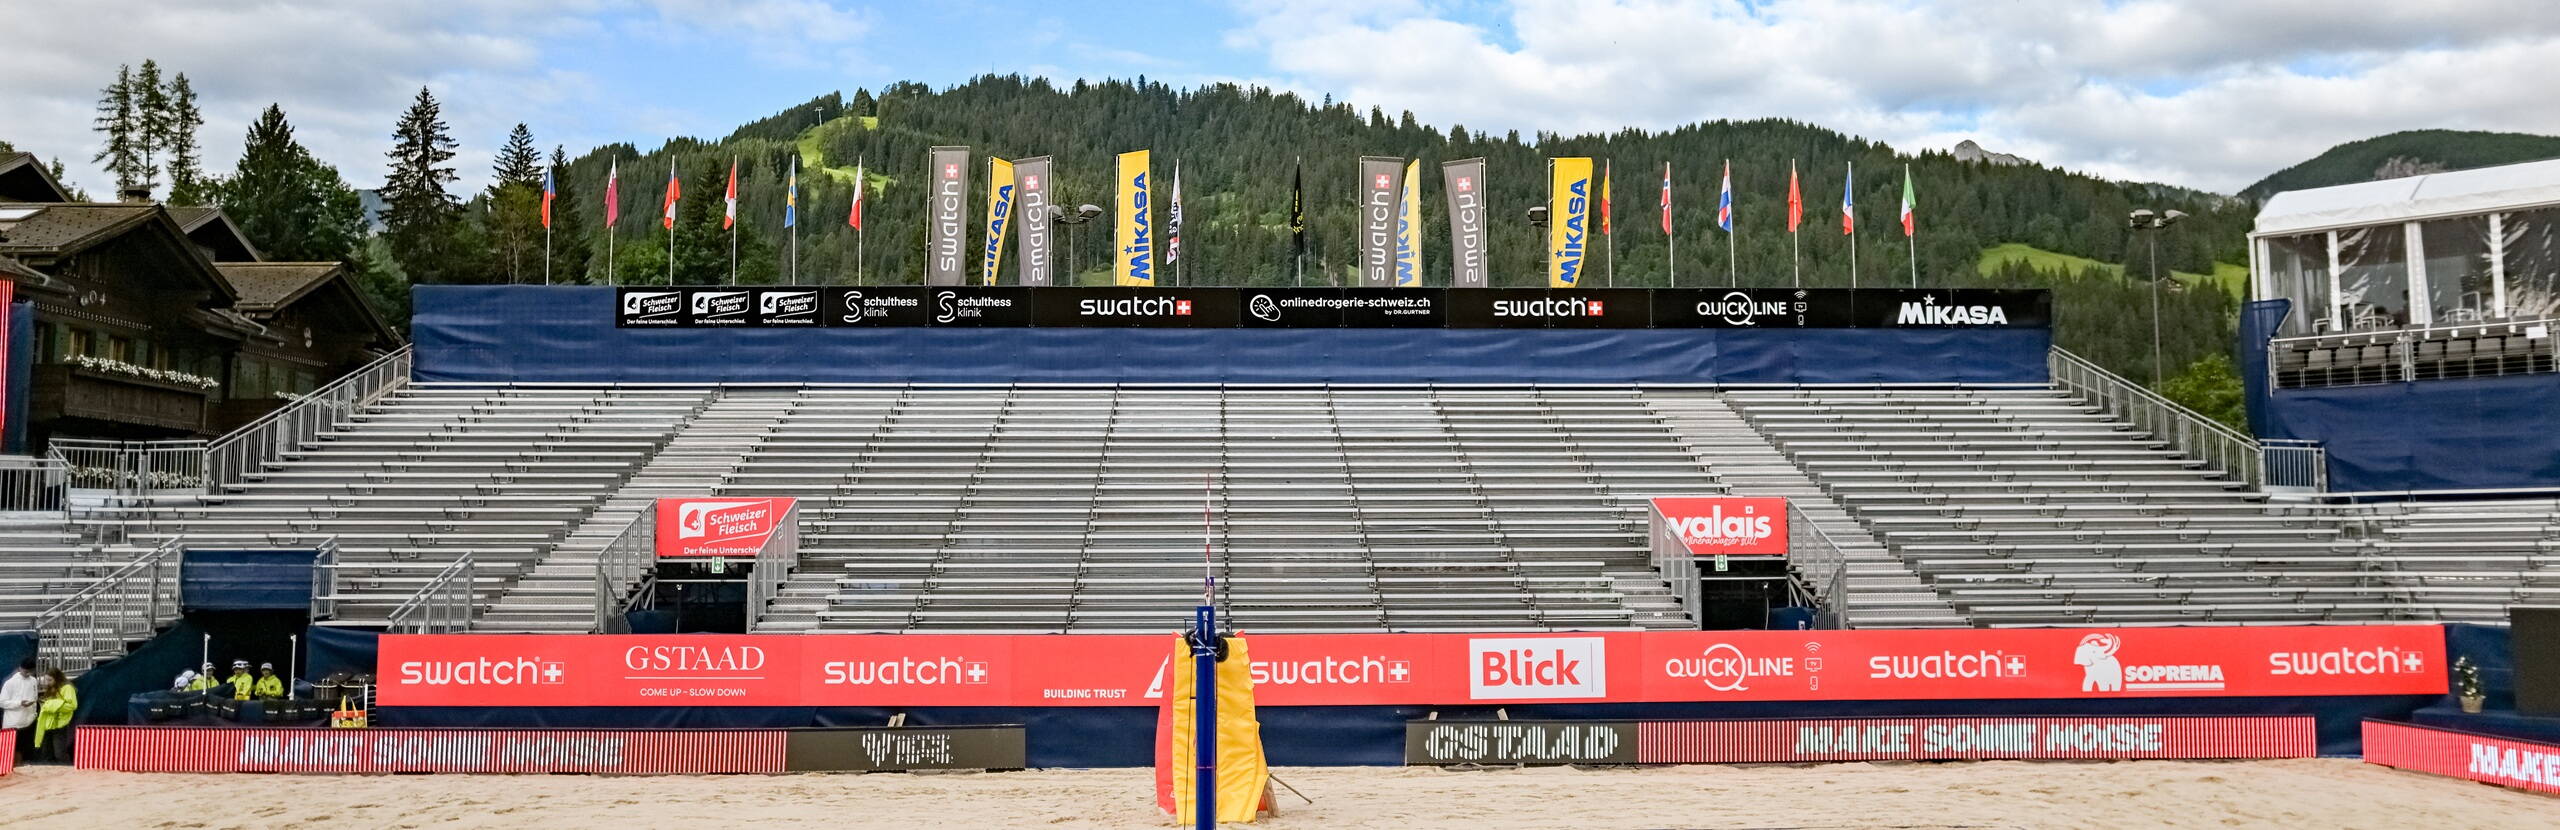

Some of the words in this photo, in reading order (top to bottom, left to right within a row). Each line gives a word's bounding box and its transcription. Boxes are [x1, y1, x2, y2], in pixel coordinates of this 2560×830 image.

[940, 180, 959, 272] swatch
[1124, 171, 1151, 280] MIKASA
[1554, 178, 1588, 284] MIKASA
[1370, 190, 1389, 281] swatch
[642, 295, 678, 308] Schweizer
[647, 303, 672, 314] Fleisch
[710, 295, 746, 308] Schweizer
[716, 303, 740, 314] Fleisch
[778, 295, 814, 308] Schweizer
[784, 303, 809, 314] Fleisch
[863, 296, 918, 307] schulthess
[957, 297, 1012, 308] schulthess
[1080, 296, 1175, 315] swatch
[1279, 297, 1431, 309] onlinedrogerie-schweiz.ch
[1493, 297, 1587, 316] swatch
[1696, 300, 1787, 317] QUICKLINE
[1897, 294, 2008, 325] MIKASA
[863, 307, 888, 317] klinik
[957, 307, 982, 317] klinik
[709, 508, 767, 526] Schweizer
[1667, 504, 1772, 539] valais
[718, 520, 758, 536] Fleisch
[683, 546, 697, 555] Der
[698, 546, 718, 555] feine
[624, 645, 766, 671] GSTAAD
[1482, 648, 1582, 687] Blick
[1665, 655, 1794, 679] QUICKLINE
[1869, 650, 2002, 678] swatch
[2269, 646, 2400, 675] swatch
[400, 656, 540, 685] swatch
[824, 656, 963, 685] swatch
[1249, 655, 1386, 684] swatch
[2124, 664, 2225, 682] SOPREMA
[639, 687, 668, 697] COME
[669, 687, 682, 697] UP
[689, 687, 716, 697] SLOW
[717, 687, 747, 697] DOWN
[1043, 688, 1092, 699] BUILDING
[1093, 688, 1128, 699] TRUST
[1425, 724, 1619, 761] GSTAAD
[1795, 724, 1914, 755] MAKE
[1923, 723, 2037, 753] SOME
[2045, 723, 2163, 752] NOISE
[239, 735, 364, 766] MAKE
[373, 735, 492, 766] SOME
[501, 736, 624, 767] NOISE
